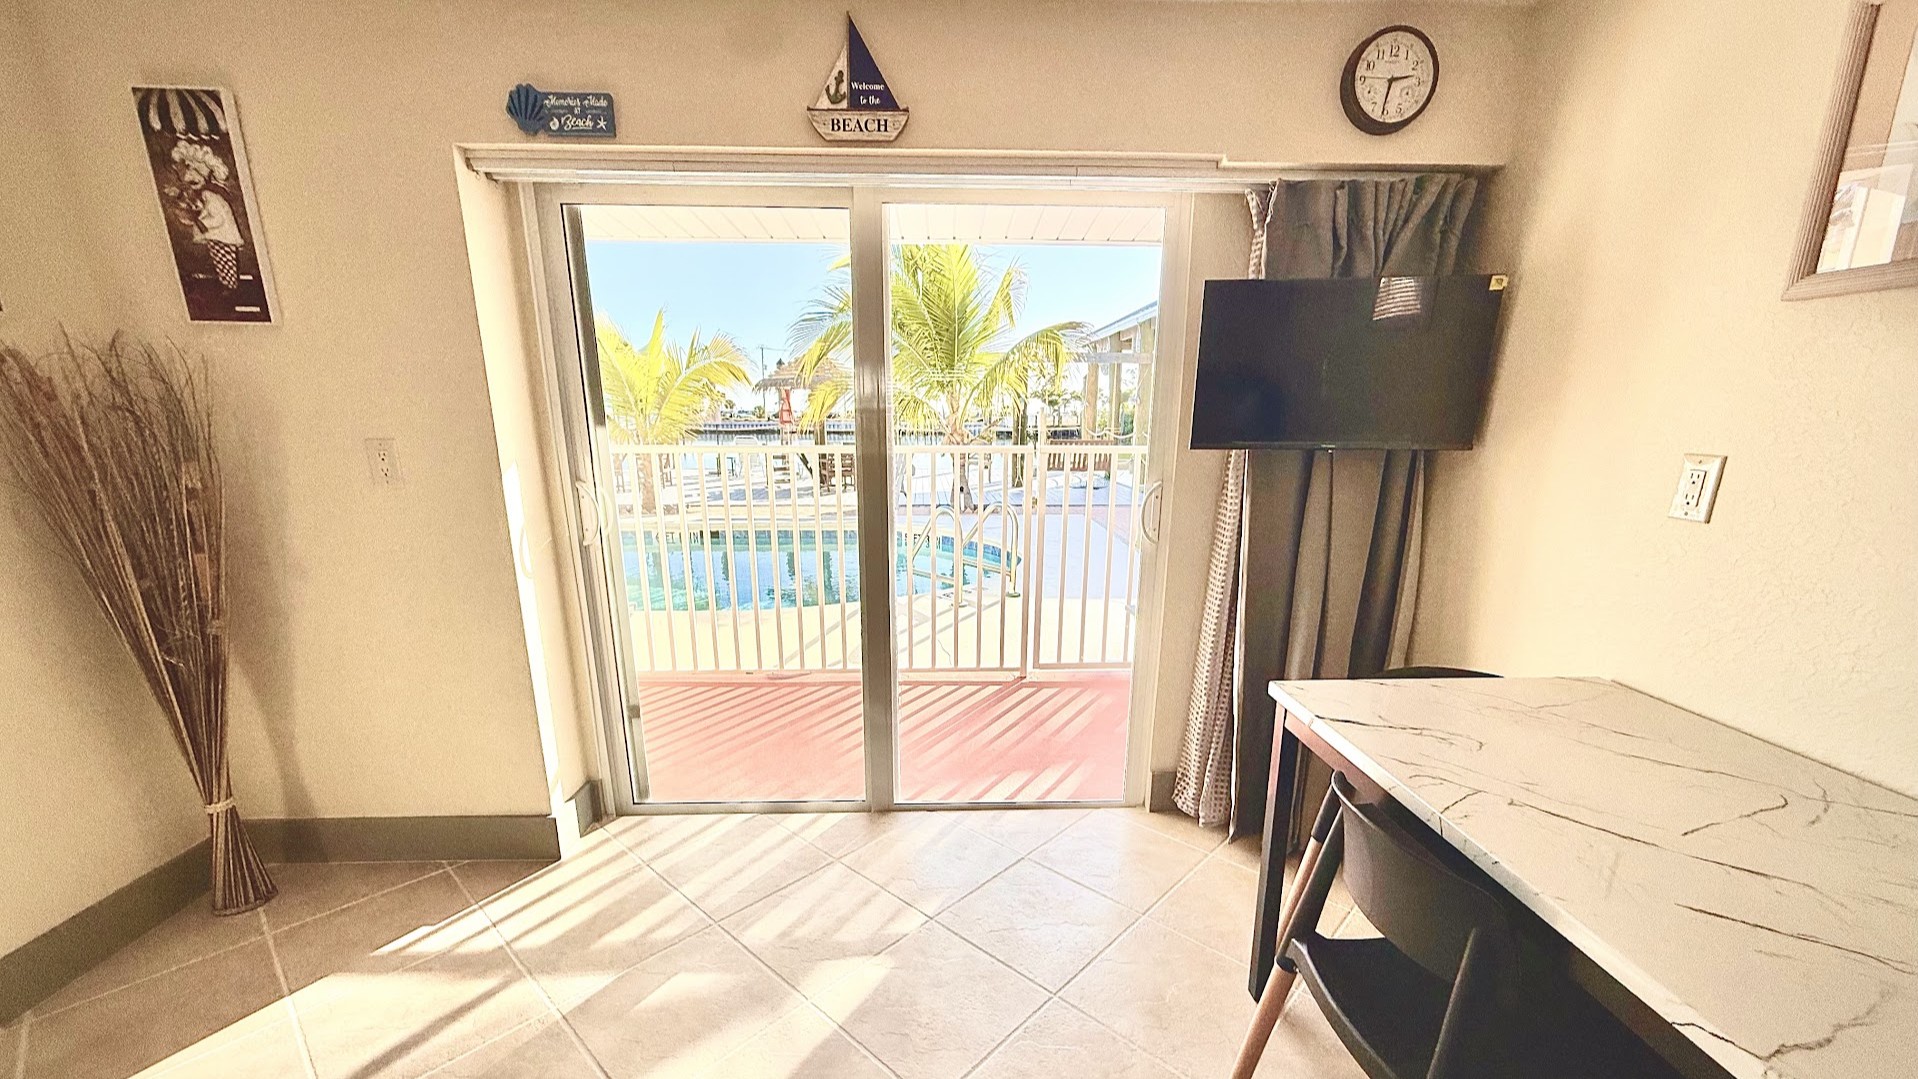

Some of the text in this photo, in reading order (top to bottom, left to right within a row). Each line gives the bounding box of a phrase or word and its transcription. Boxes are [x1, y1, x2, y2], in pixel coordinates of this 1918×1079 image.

[1376, 48, 1385, 60] 11
[1389, 44, 1400, 58] 12
[1405, 49, 1409, 61] 1
[1365, 60, 1376, 71] 10
[1411, 60, 1419, 71] 2
[851, 81, 885, 91] Welcome
[1359, 75, 1366, 86] 9
[1414, 76, 1421, 87] 3
[860, 95, 881, 106] to the
[1371, 101, 1377, 112] 7
[561, 114, 594, 131] Beach
[830, 117, 889, 133] BEACH
